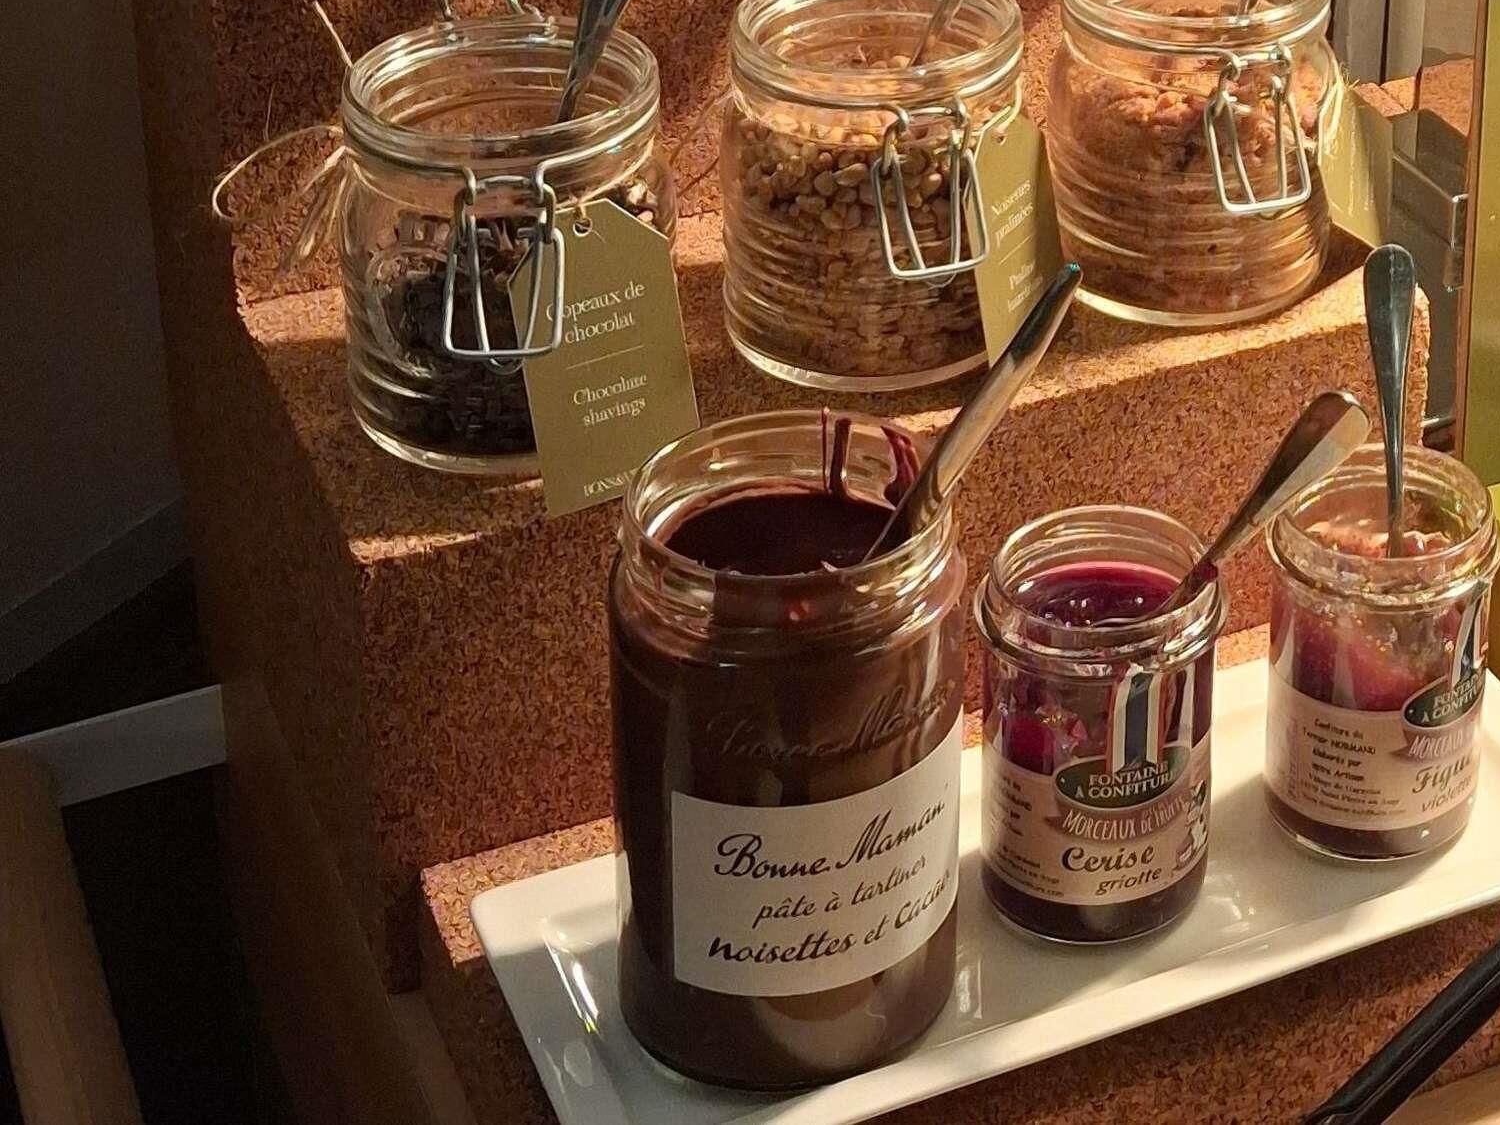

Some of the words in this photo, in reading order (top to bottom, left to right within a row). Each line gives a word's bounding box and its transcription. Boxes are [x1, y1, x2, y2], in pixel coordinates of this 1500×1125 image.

[624, 280, 646, 300] de
[564, 311, 636, 344] chocolat
[583, 396, 647, 426] shavings
[713, 833, 832, 879] Bonne
[834, 799, 946, 870] Maman
[1062, 809, 1137, 841] MORCEAUX
[1061, 845, 1154, 873] Cerise
[753, 896, 817, 929] pâte
[824, 890, 842, 914] à
[850, 854, 927, 907] tartiner
[1094, 868, 1163, 896] griotte
[707, 932, 858, 964] noisettes
[862, 916, 890, 946] et
